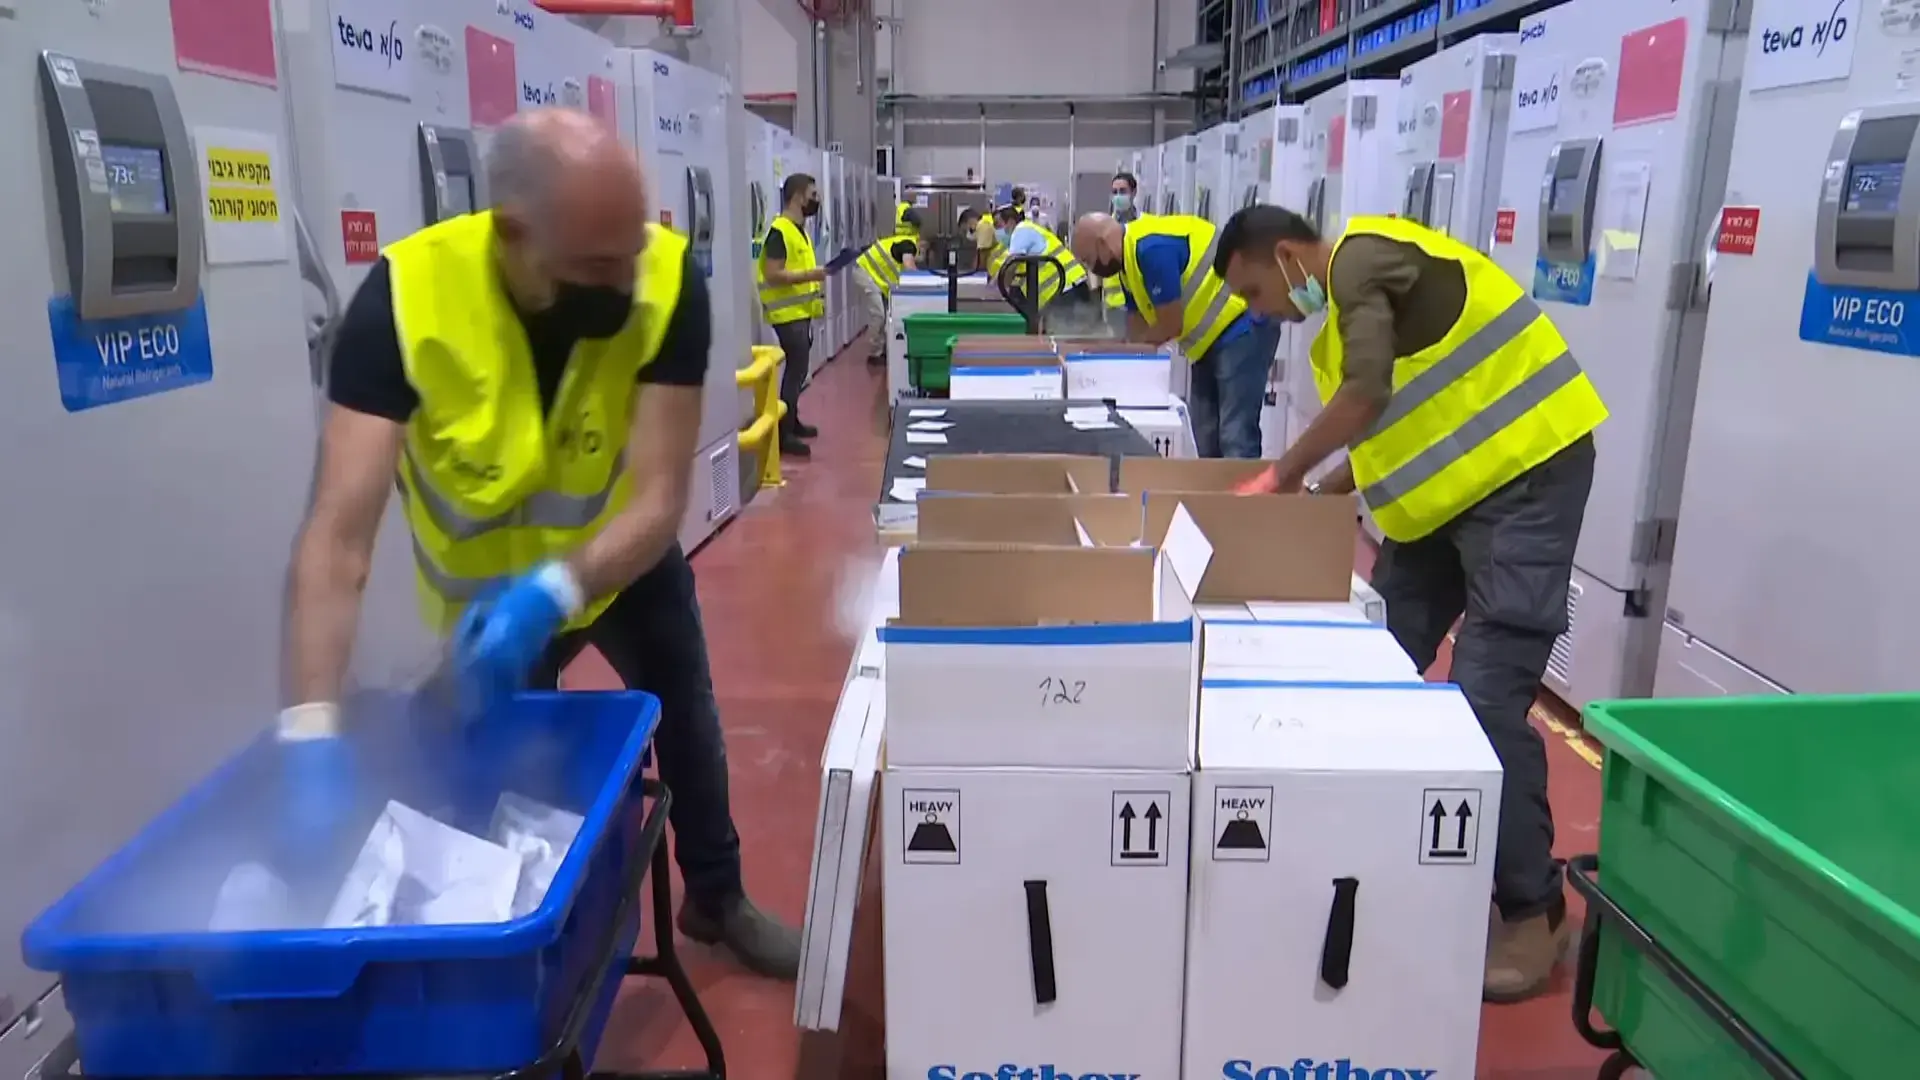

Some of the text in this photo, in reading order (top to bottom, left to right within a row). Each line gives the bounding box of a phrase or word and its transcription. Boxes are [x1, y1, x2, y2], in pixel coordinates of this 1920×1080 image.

[338, 15, 373, 51] teva
[1762, 26, 1804, 54] teva
[208, 159, 270, 186] מקפיא גיבוי
[209, 198, 278, 222] חיסוני קורונה
[1833, 295, 1905, 328] VIP ECO
[95, 323, 179, 367] VIP ECO
[1039, 676, 1086, 706] 122
[909, 801, 953, 813] HEAVY
[1221, 798, 1265, 810] HEAVY
